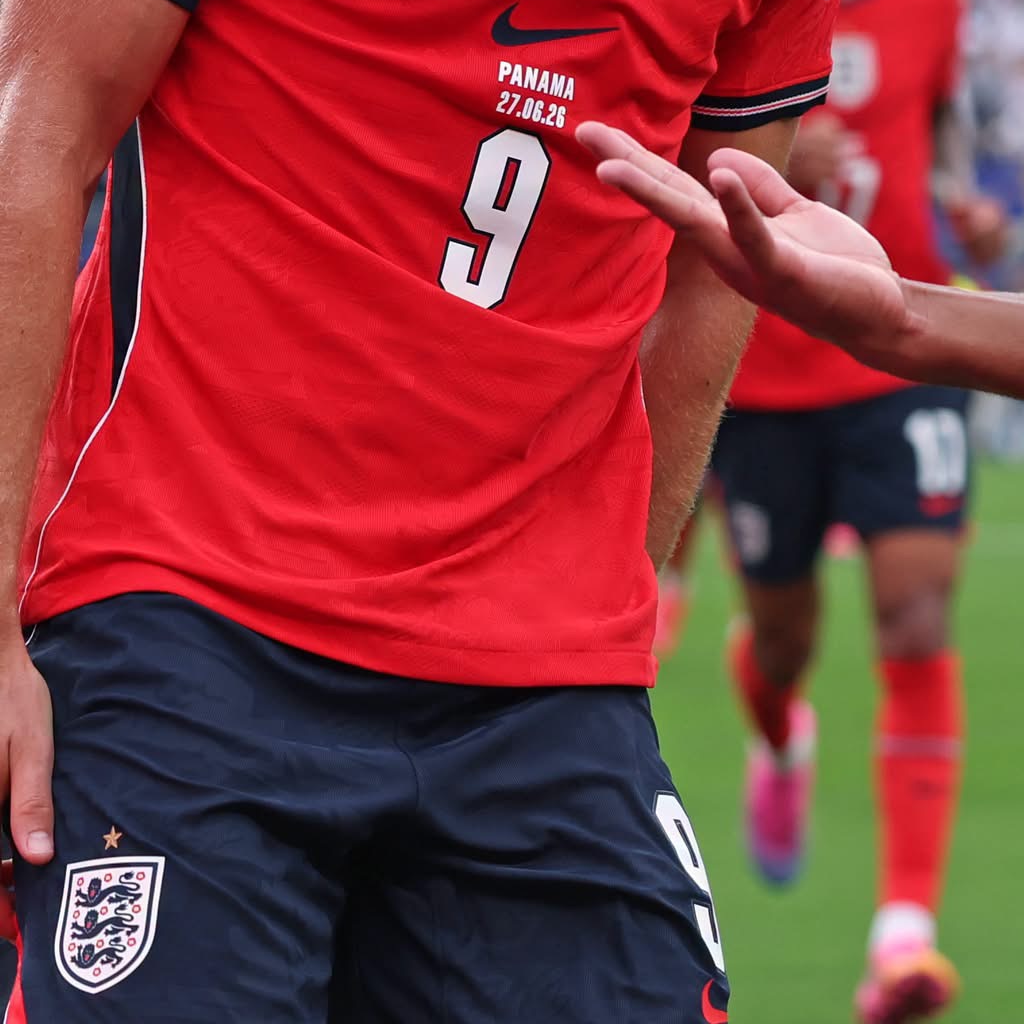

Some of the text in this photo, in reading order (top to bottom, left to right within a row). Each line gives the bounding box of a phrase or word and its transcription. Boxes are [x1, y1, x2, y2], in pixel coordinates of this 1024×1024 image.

[495, 90, 567, 129] 27.06.26
[497, 60, 575, 101] PANAMA
[438, 126, 551, 310] 9
[653, 792, 727, 974] 9
